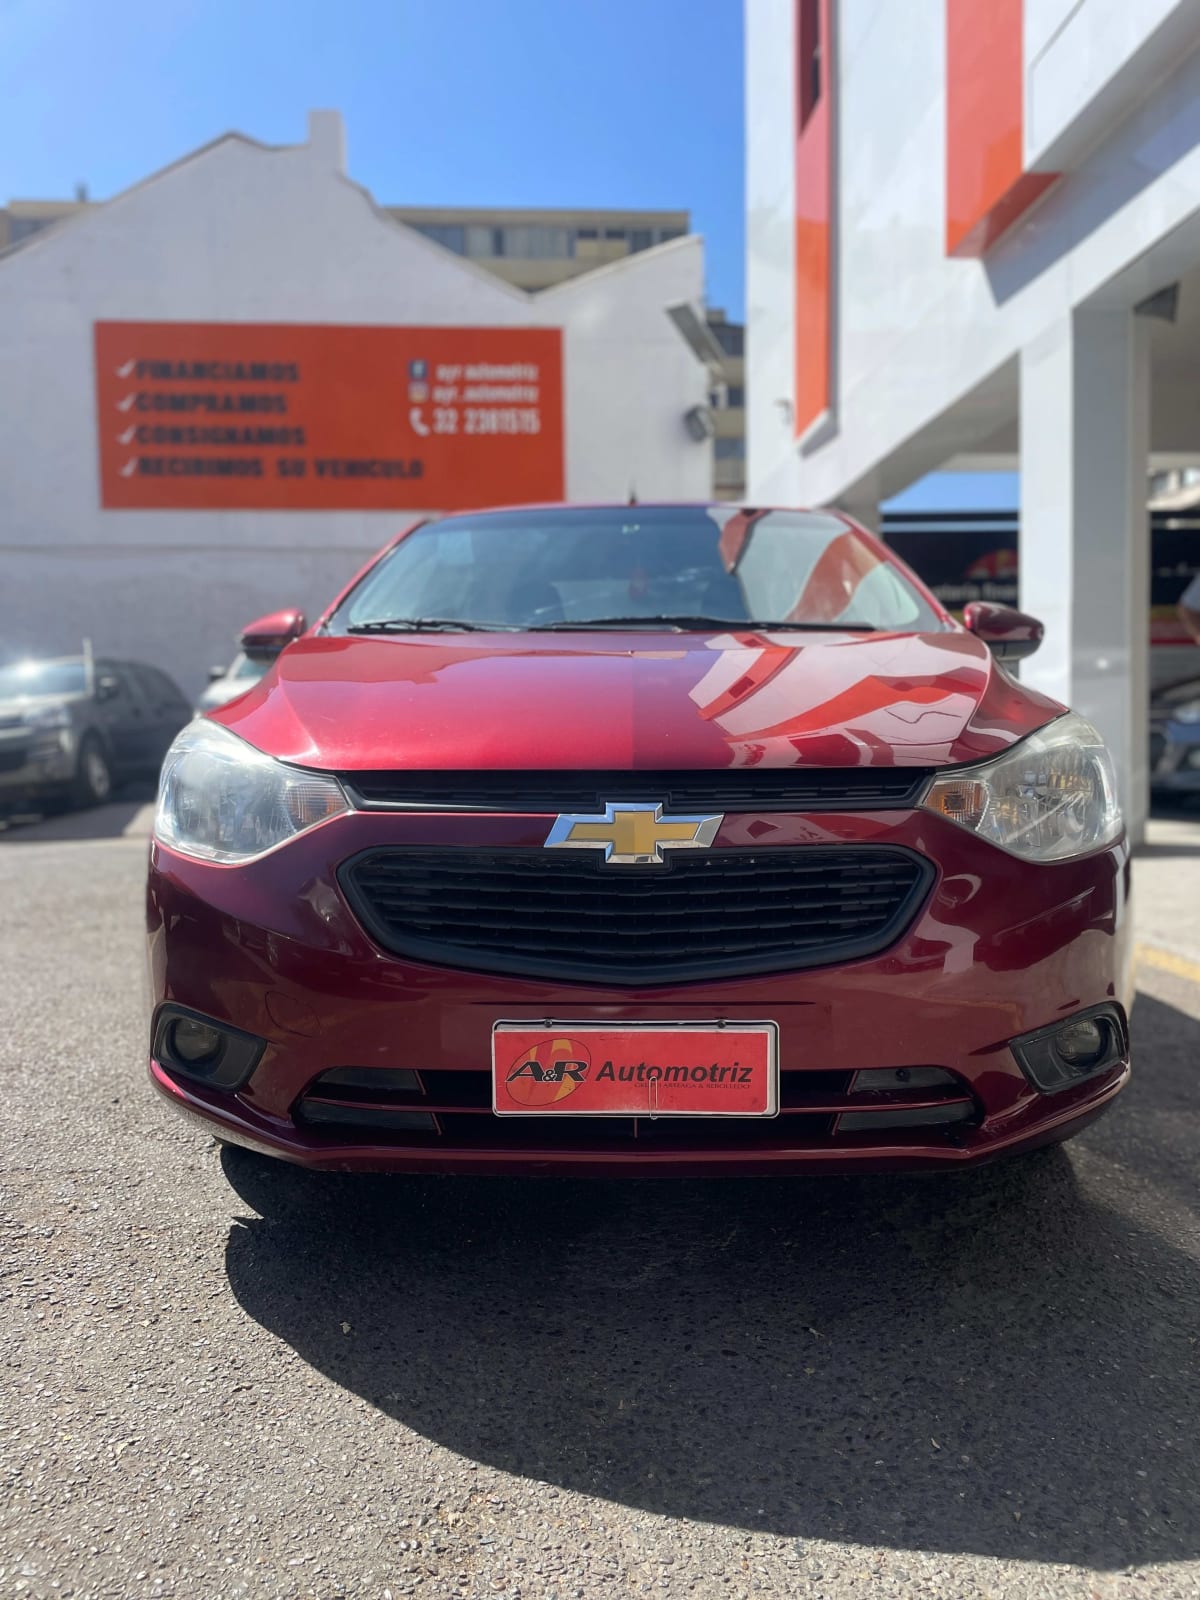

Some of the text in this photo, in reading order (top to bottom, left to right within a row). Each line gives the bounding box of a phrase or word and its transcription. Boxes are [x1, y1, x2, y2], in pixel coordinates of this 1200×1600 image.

[137, 359, 299, 379] FINANCIAMOS
[136, 392, 286, 412] COMPRAMOS
[136, 425, 306, 445] CONSIGNAMOS
[139, 457, 424, 479] RECIBIMOS SU VEHICULO
[504, 1061, 753, 1082] A&R Automotriz
